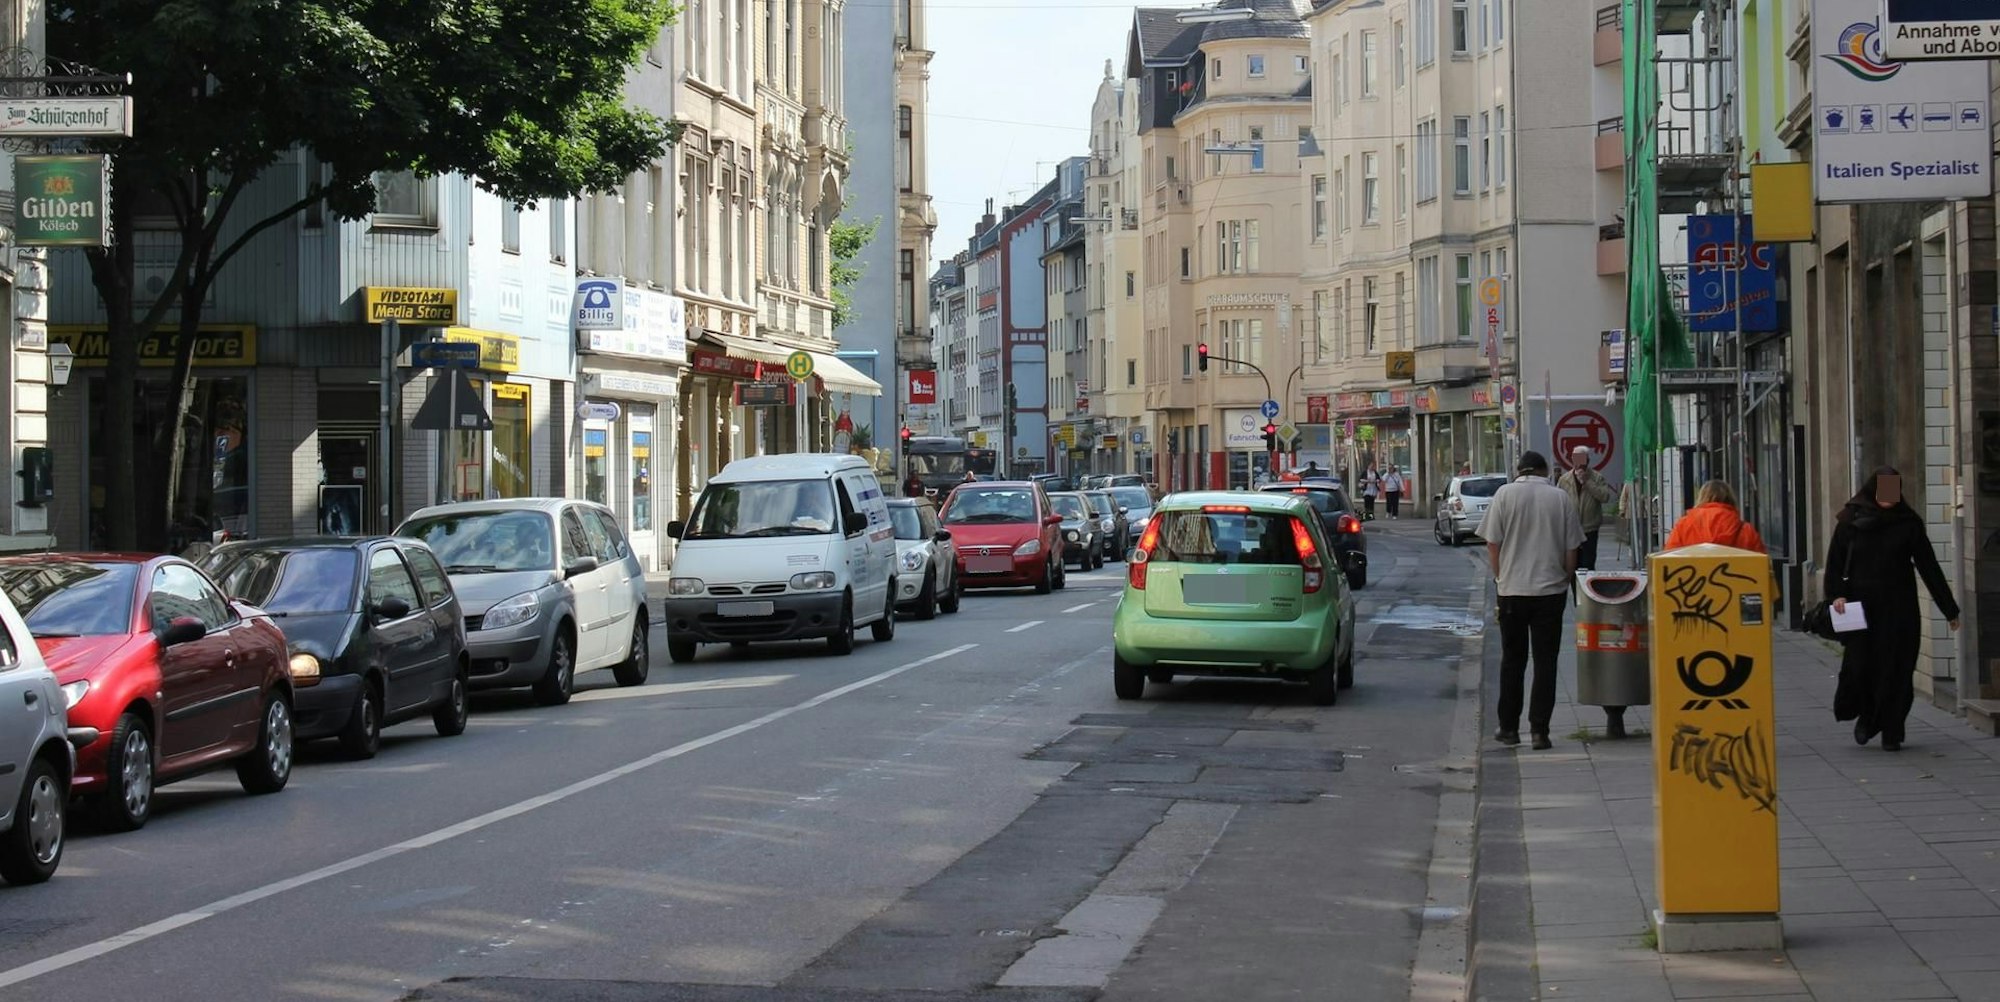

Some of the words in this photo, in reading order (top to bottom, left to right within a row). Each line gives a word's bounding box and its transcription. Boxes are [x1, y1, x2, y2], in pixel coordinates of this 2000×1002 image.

[1896, 23, 1981, 39] Annahme
[1923, 39, 1956, 54] und
[1960, 38, 2000, 53] Abo
[8, 107, 26, 120] Zum
[27, 106, 109, 127] Schützenhof
[1826, 163, 1884, 178] Italien
[1890, 160, 1979, 180] Spezialist
[22, 197, 95, 218] Gilden
[39, 219, 79, 232] Kölsch
[1695, 241, 1770, 275] ABC
[375, 304, 414, 318] Media
[416, 305, 451, 319] Store
[579, 309, 614, 322] Billig
[794, 357, 806, 372] H
